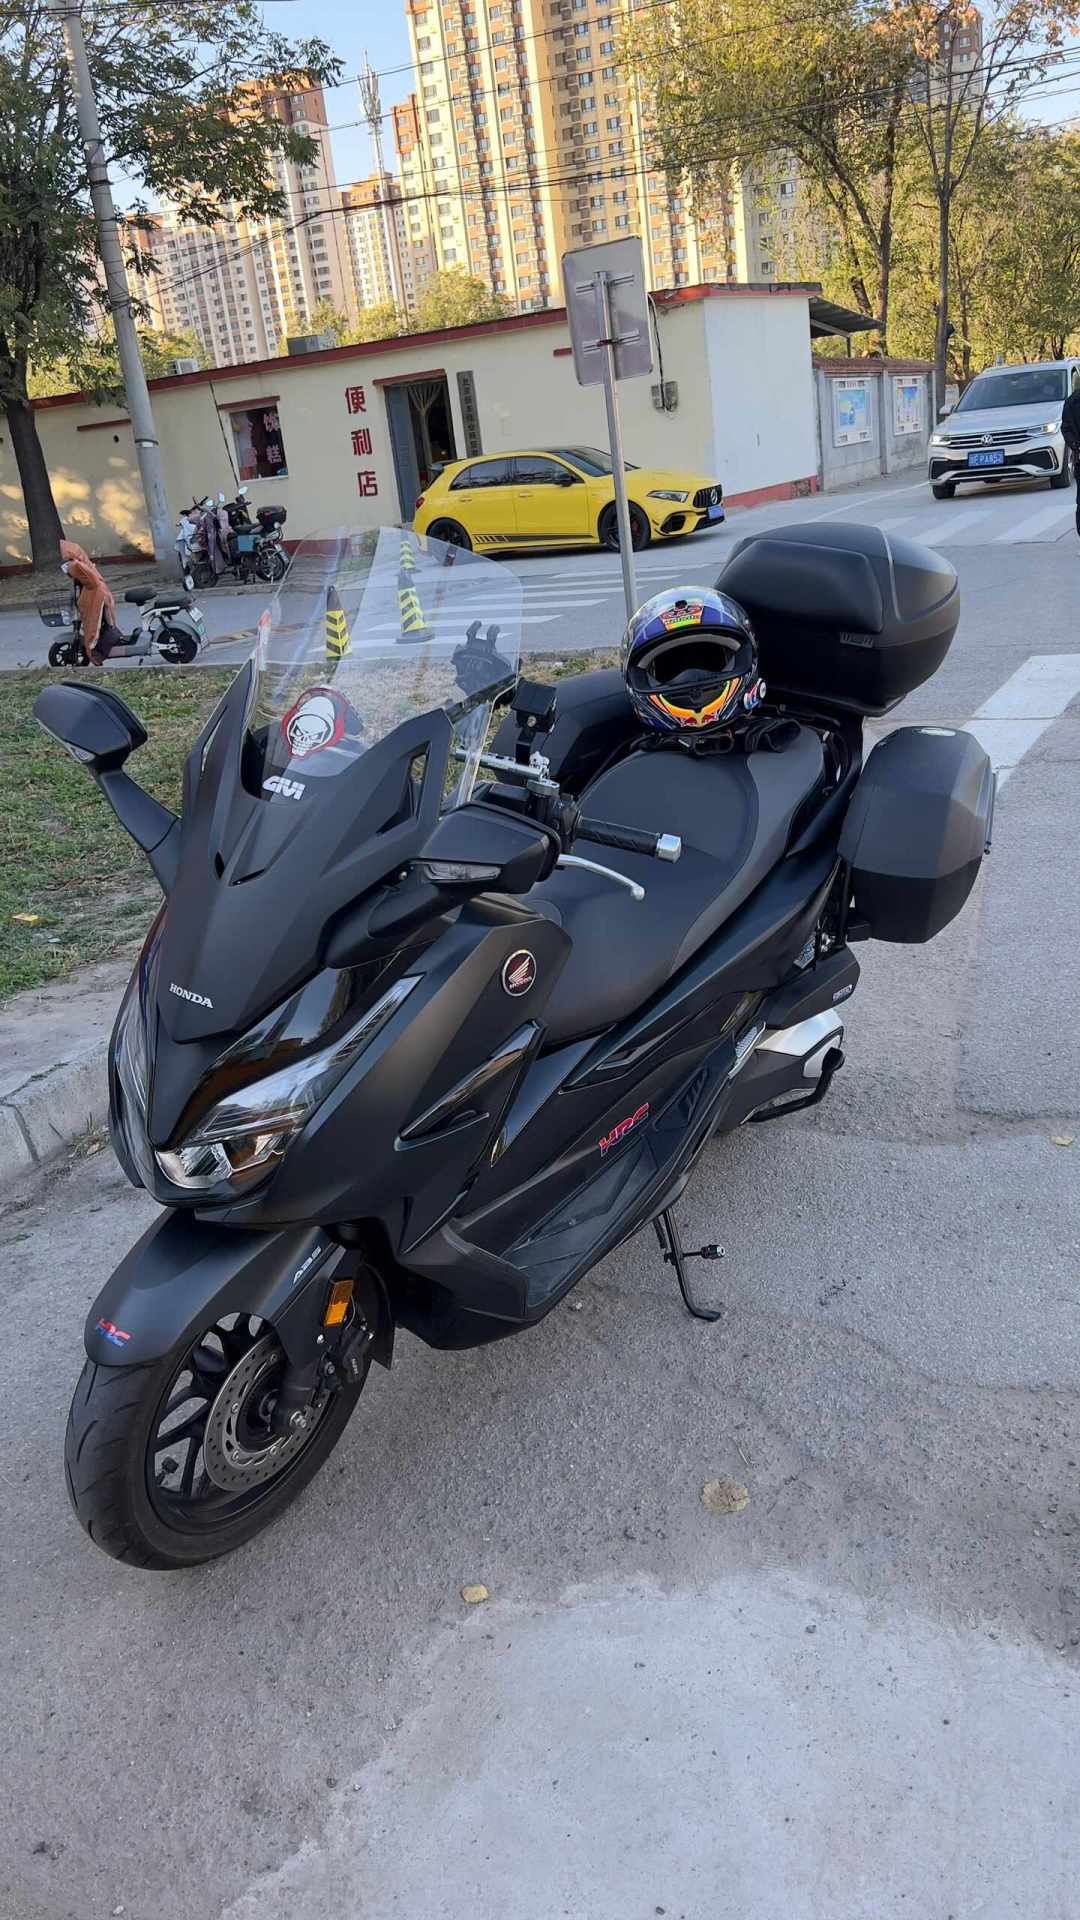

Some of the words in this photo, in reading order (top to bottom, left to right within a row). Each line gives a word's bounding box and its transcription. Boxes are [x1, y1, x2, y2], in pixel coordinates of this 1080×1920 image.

[345, 385, 379, 497] 便利店
[262, 775, 306, 800] GIVI
[169, 982, 214, 1009] HONDA
[293, 1245, 321, 1284] ABS
